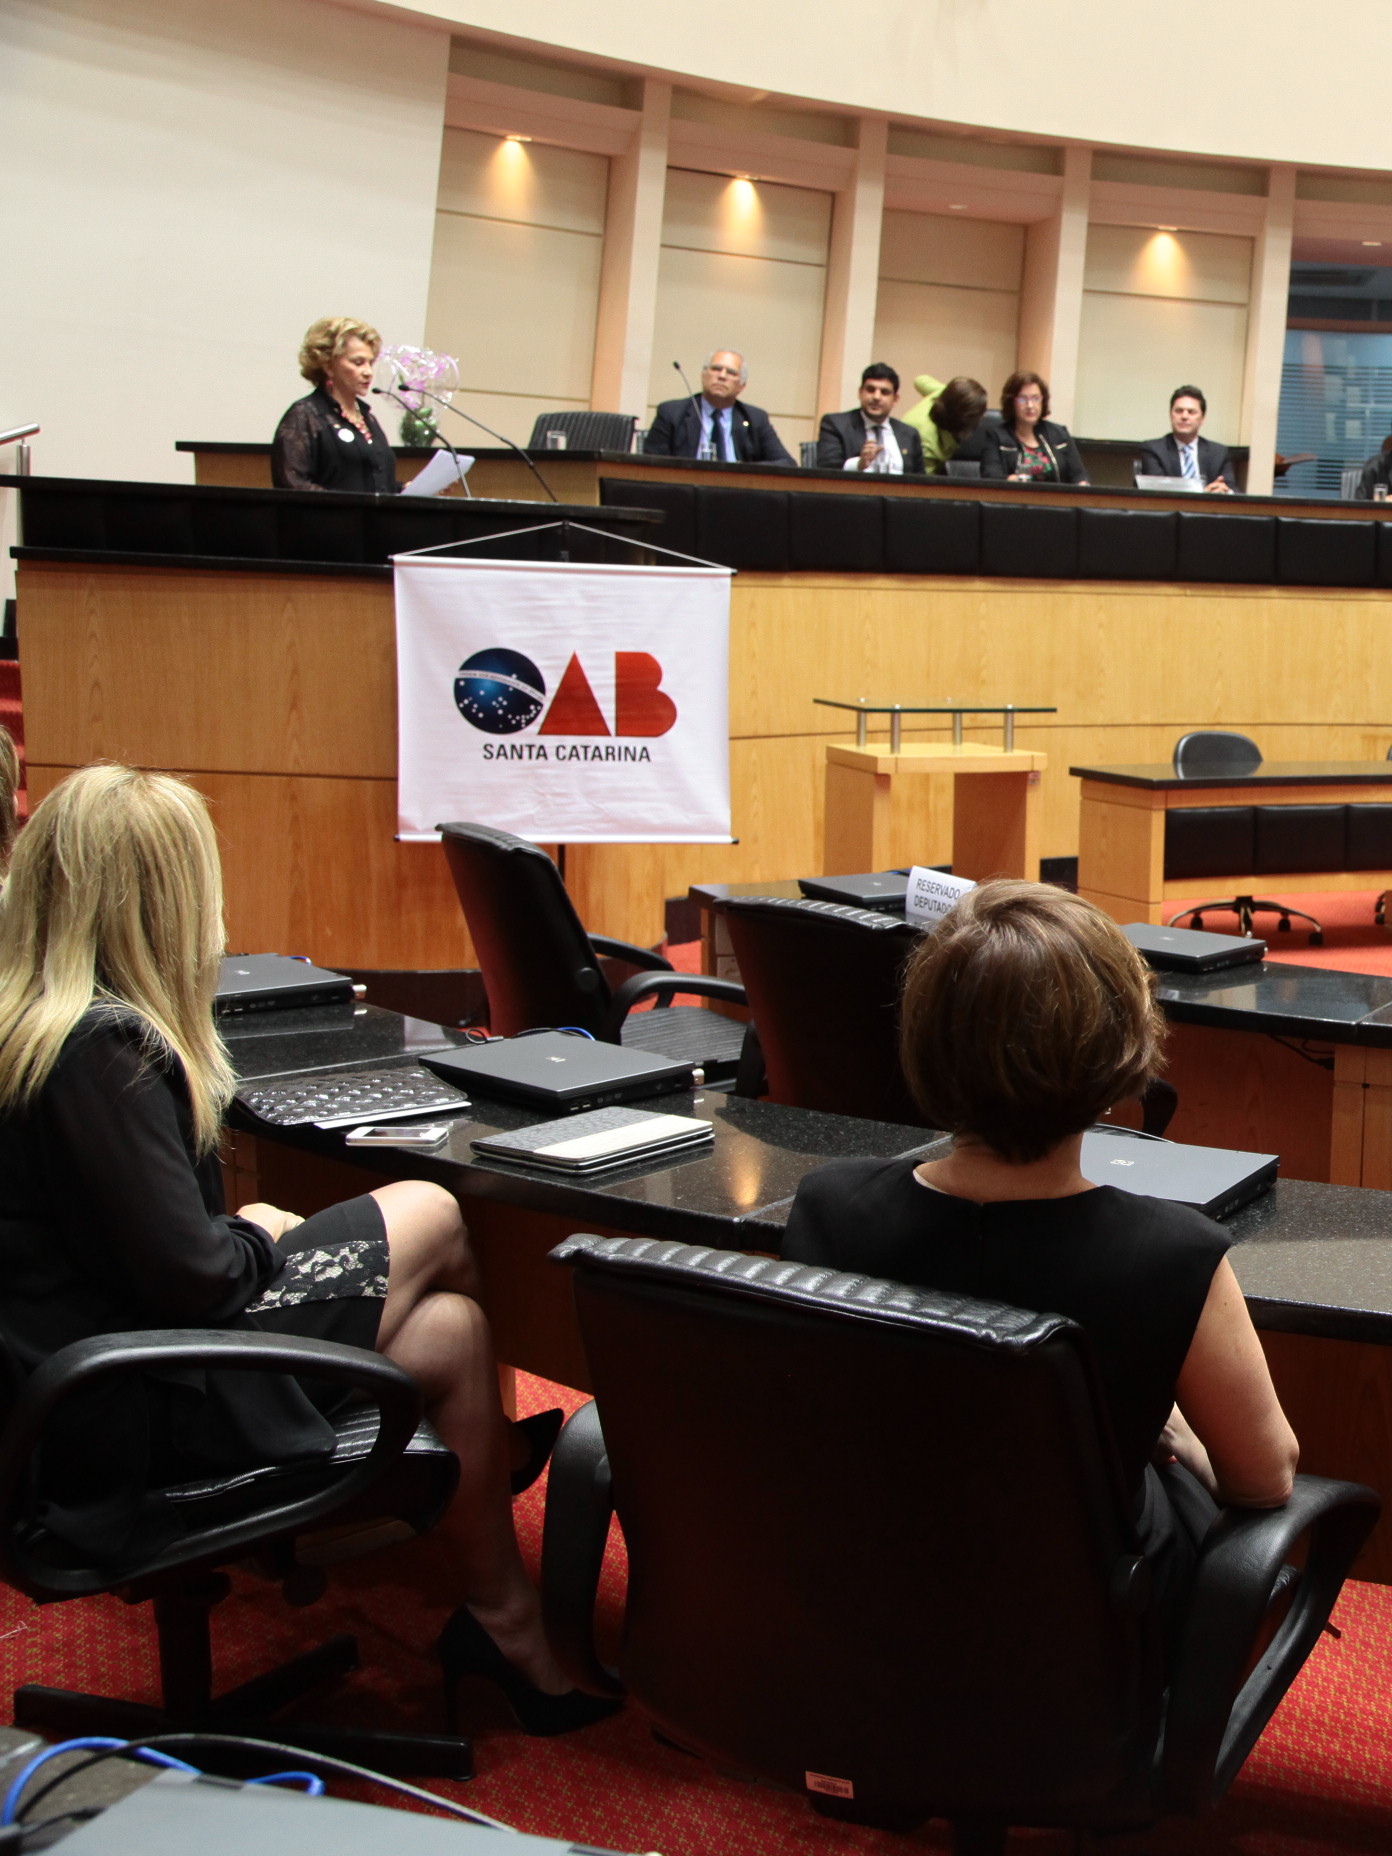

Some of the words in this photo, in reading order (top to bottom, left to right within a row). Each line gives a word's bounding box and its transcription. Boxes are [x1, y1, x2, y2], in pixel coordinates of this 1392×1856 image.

[453, 647, 678, 738] OAB
[483, 743, 548, 760] SANTA
[555, 744, 651, 762] CATARINA
[916, 878, 961, 900] RESERVADO
